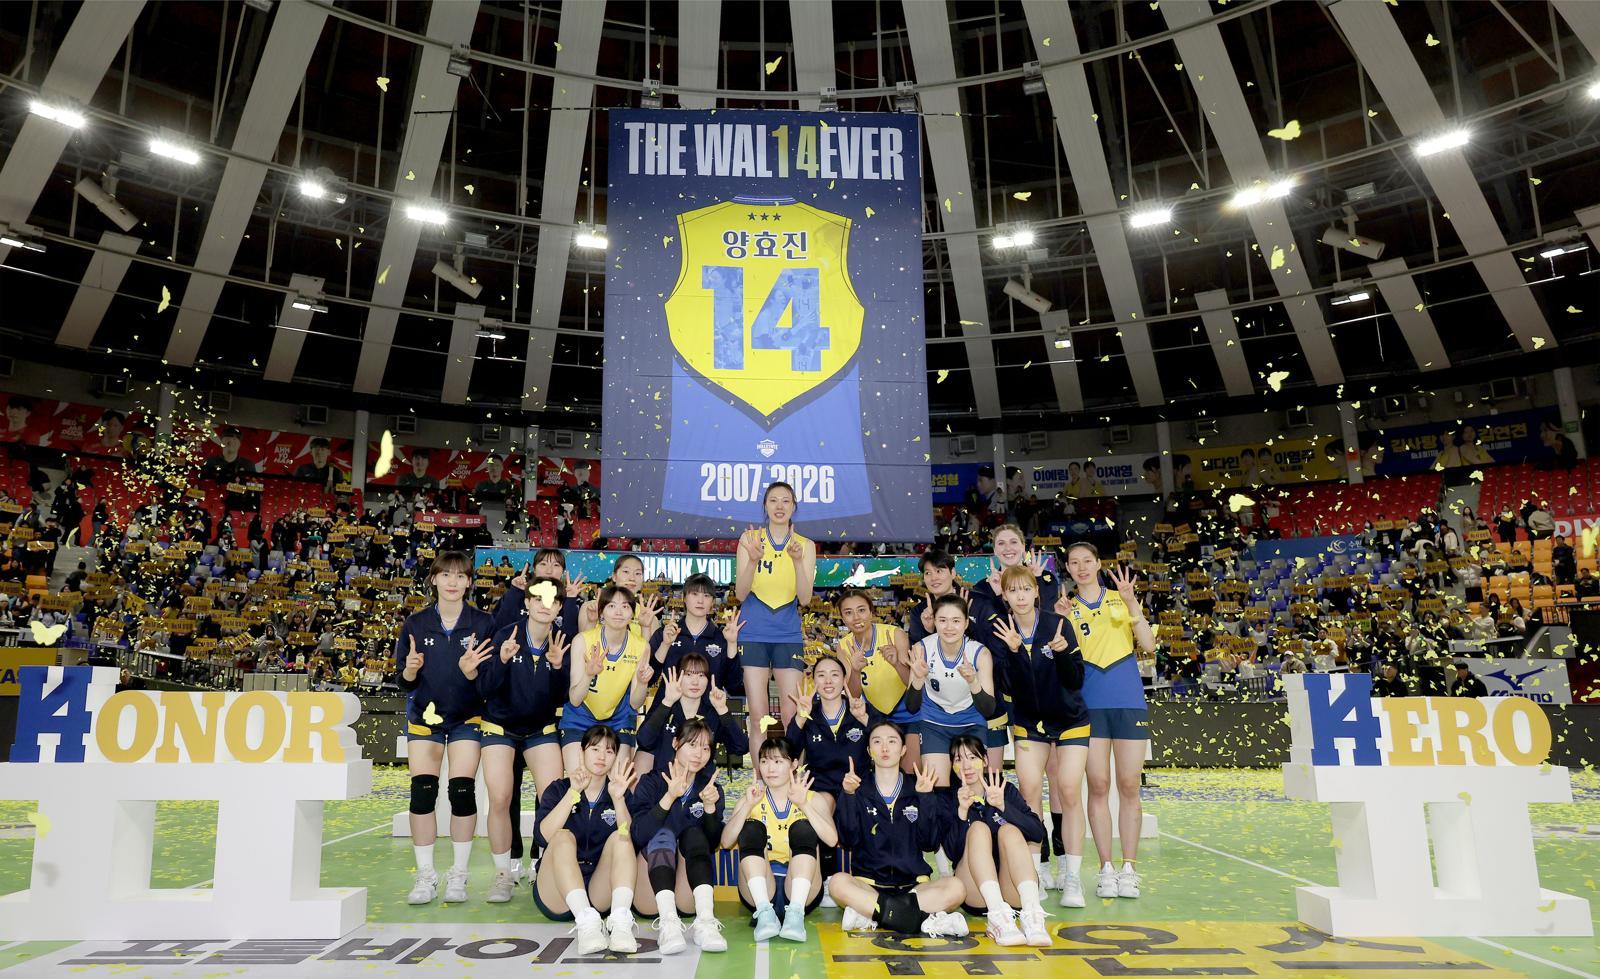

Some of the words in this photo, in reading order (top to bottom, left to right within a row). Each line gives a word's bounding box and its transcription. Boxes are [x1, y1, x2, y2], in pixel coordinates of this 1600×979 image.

[624, 122, 687, 176] THE
[693, 123, 905, 180] WAL14EVER
[722, 229, 809, 261] 양효진
[702, 265, 830, 372] 14
[696, 556, 732, 583] YOU
[757, 559, 773, 574] 14
[1080, 623, 1091, 636] 9
